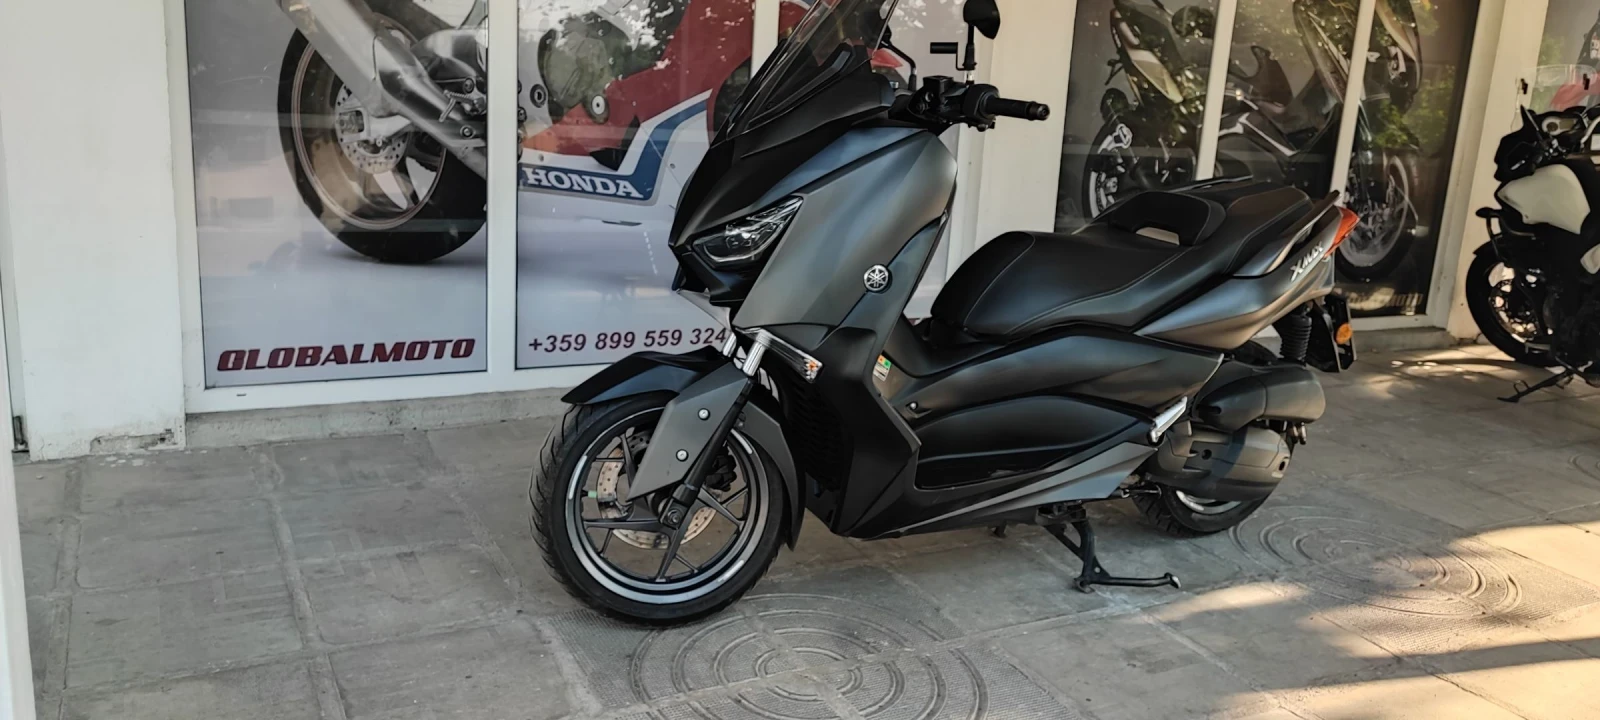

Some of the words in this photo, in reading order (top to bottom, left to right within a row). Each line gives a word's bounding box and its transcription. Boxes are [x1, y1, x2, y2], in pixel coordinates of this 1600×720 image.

[522, 167, 644, 199] HONDA
[1290, 241, 1324, 282] XMAX
[217, 338, 476, 372] GLOBALMOTO
[529, 333, 587, 353] +359
[595, 331, 636, 350] 899
[643, 328, 683, 347] 559
[690, 327, 727, 345] 324
